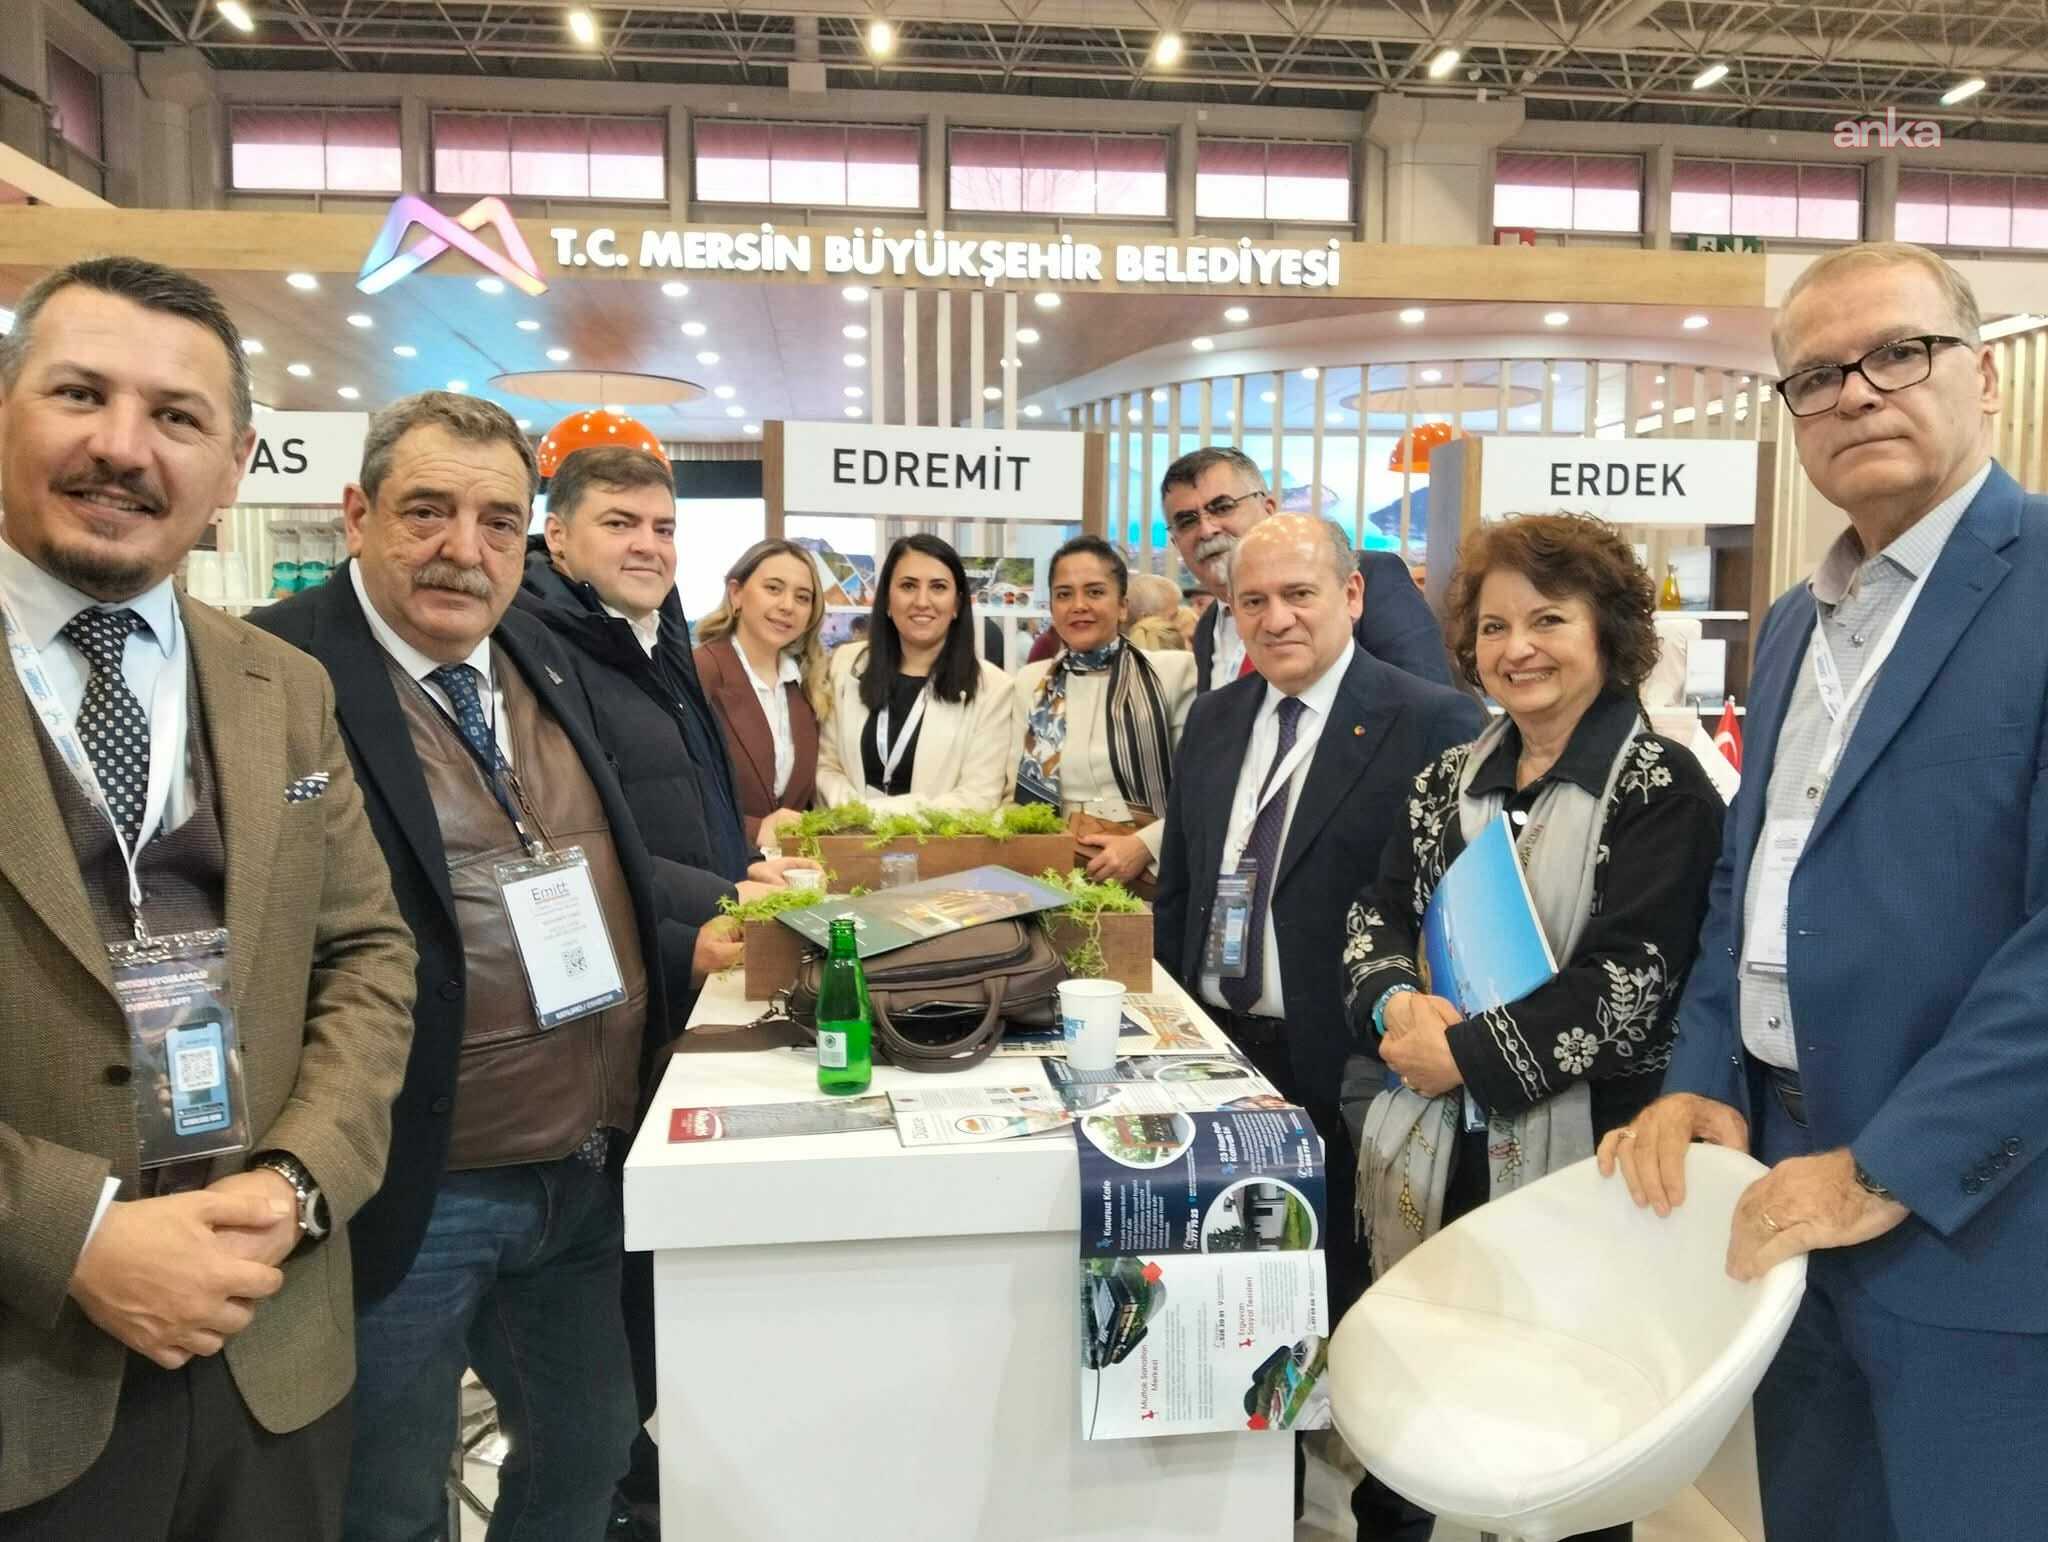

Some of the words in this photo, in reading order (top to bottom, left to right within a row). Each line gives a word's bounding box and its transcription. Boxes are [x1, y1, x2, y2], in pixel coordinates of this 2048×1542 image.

[550, 226, 629, 269] T.C.
[639, 221, 812, 272] MERSİN
[824, 226, 1103, 288] BÜYÜKŞEHİR
[1116, 236, 1341, 288] BELEDİYESİ
[833, 445, 1031, 492] EDREMİT
[1550, 462, 1687, 497] ERDEK
[1103, 1180, 1112, 1201] Kafe
